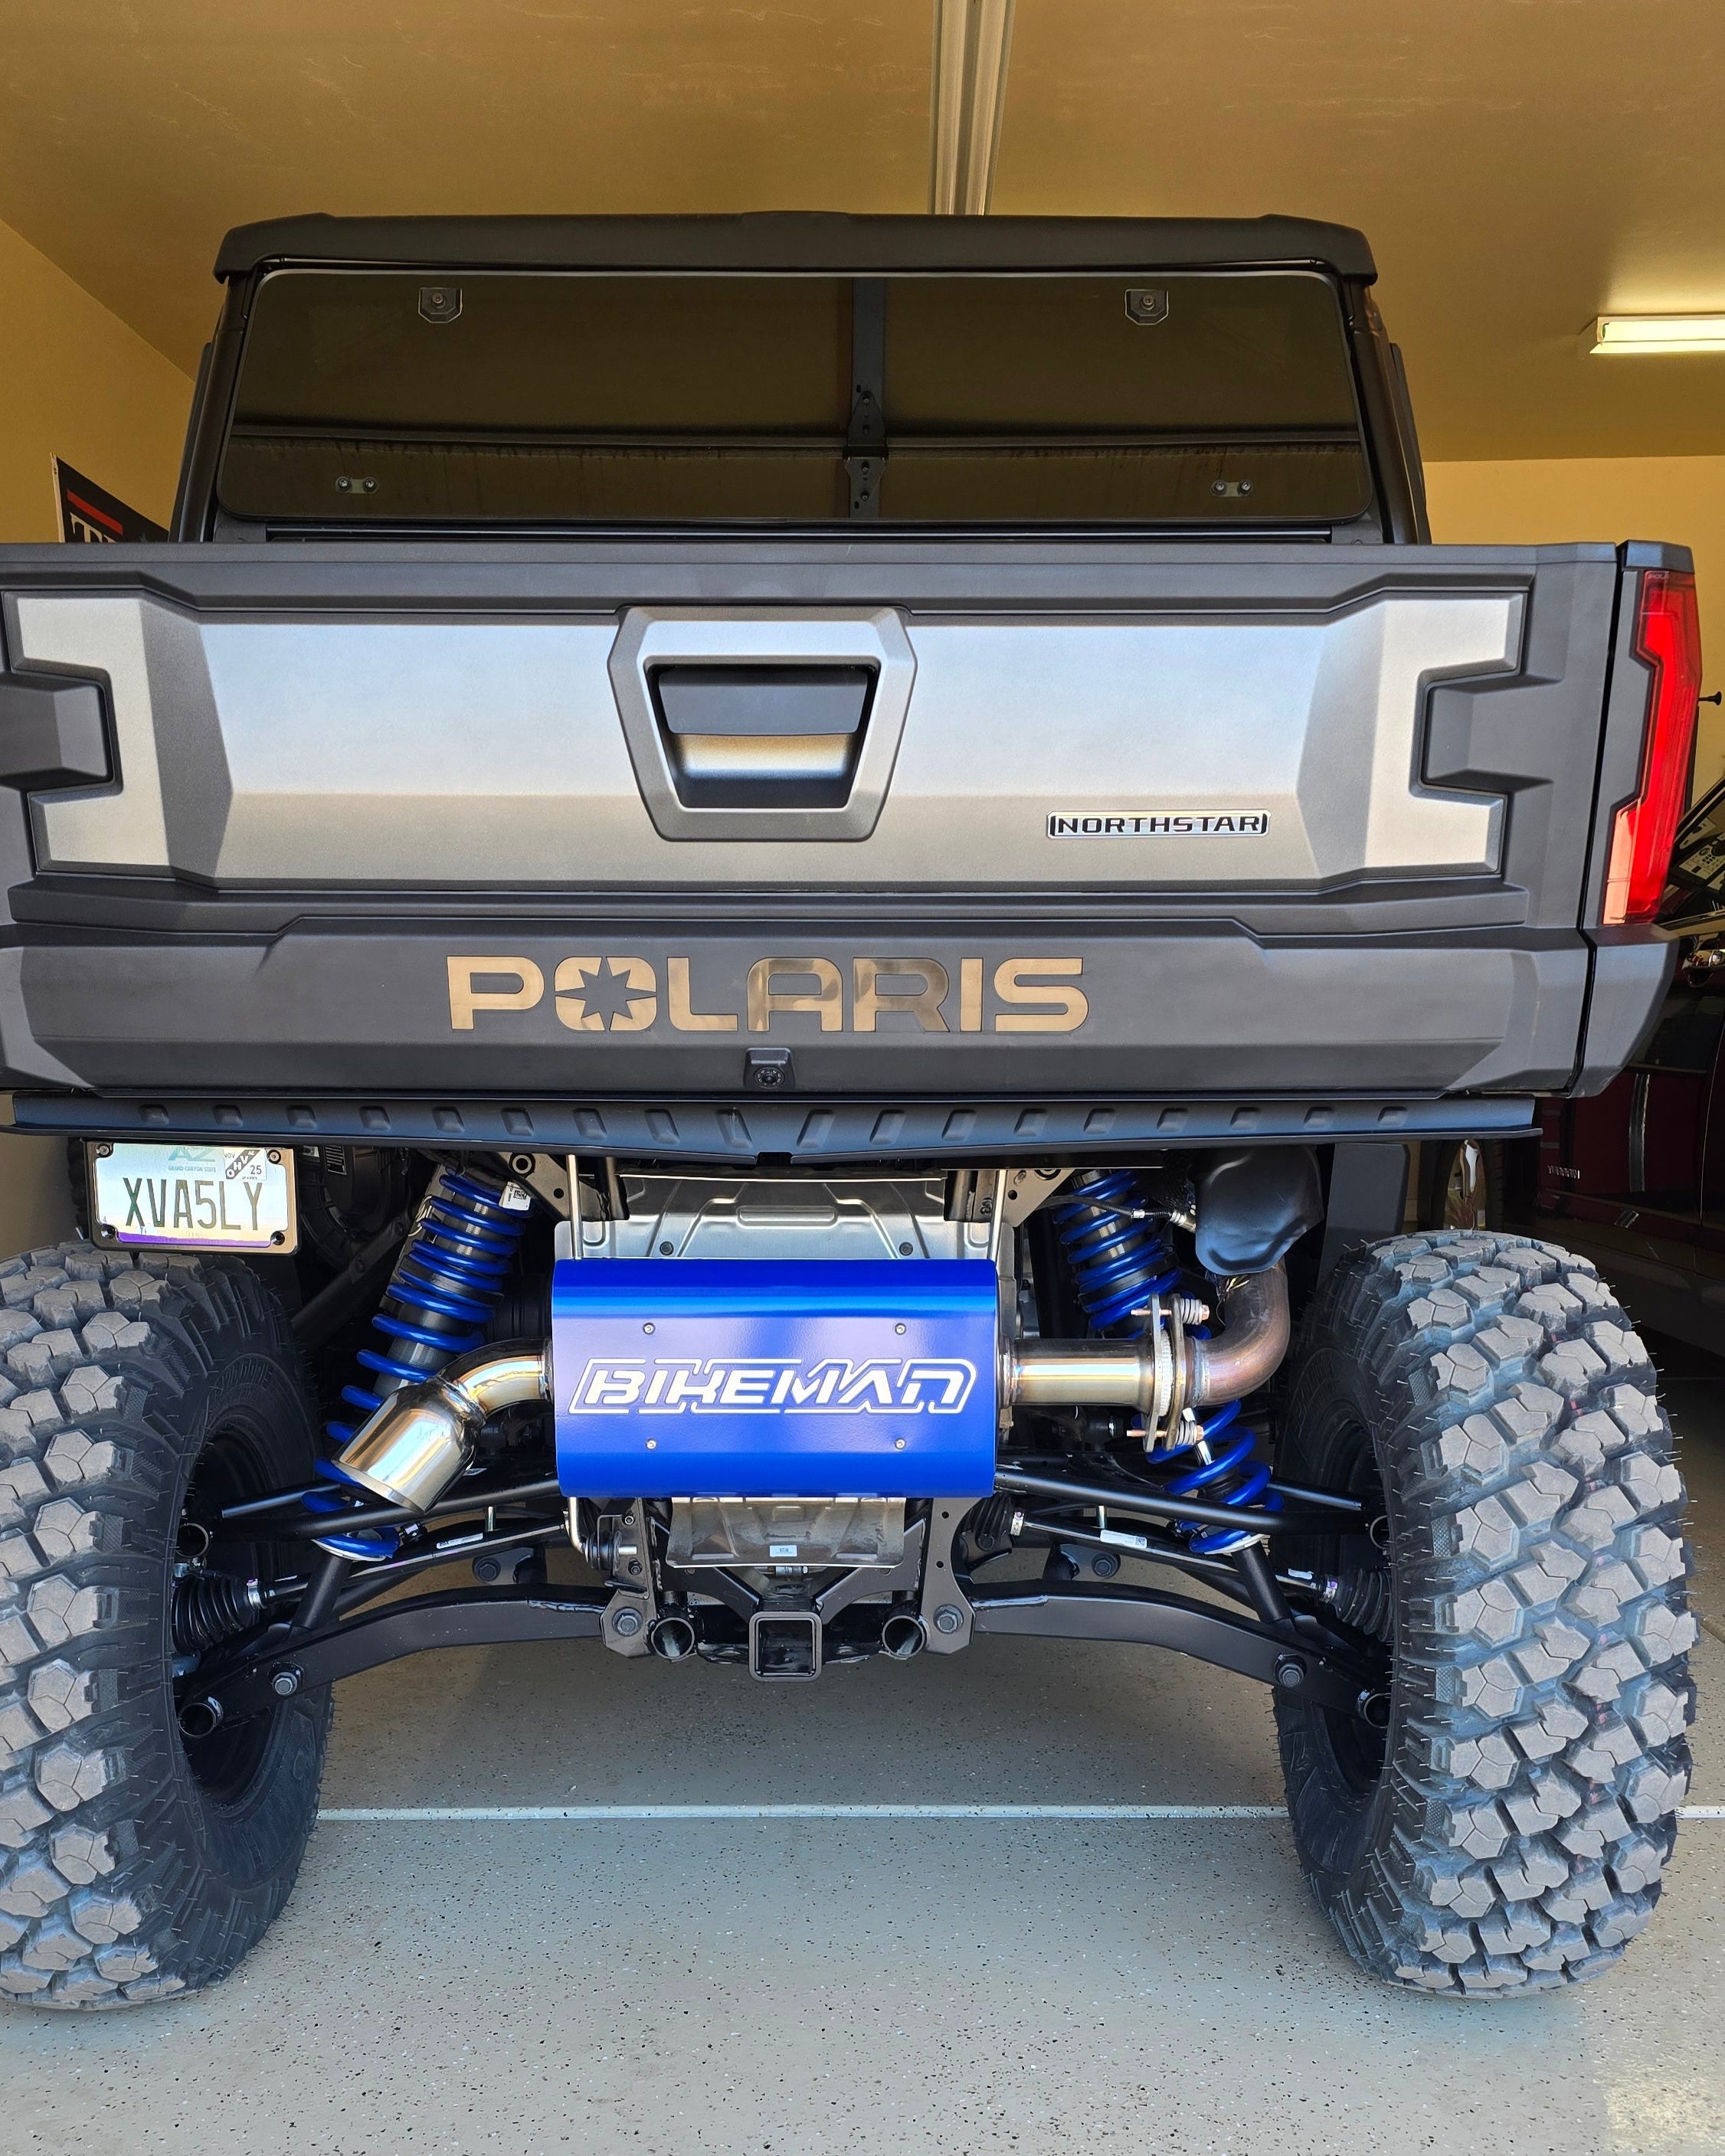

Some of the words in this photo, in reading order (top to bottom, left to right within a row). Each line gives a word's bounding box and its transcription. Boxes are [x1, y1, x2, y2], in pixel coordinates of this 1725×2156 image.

[1057, 816, 1260, 833] NORTHSTAR
[447, 956, 1089, 1033] POLARIS
[250, 1165, 262, 1175] 25
[123, 1176, 263, 1231] XVA5LY
[570, 1359, 976, 1412] BIKEMAN
